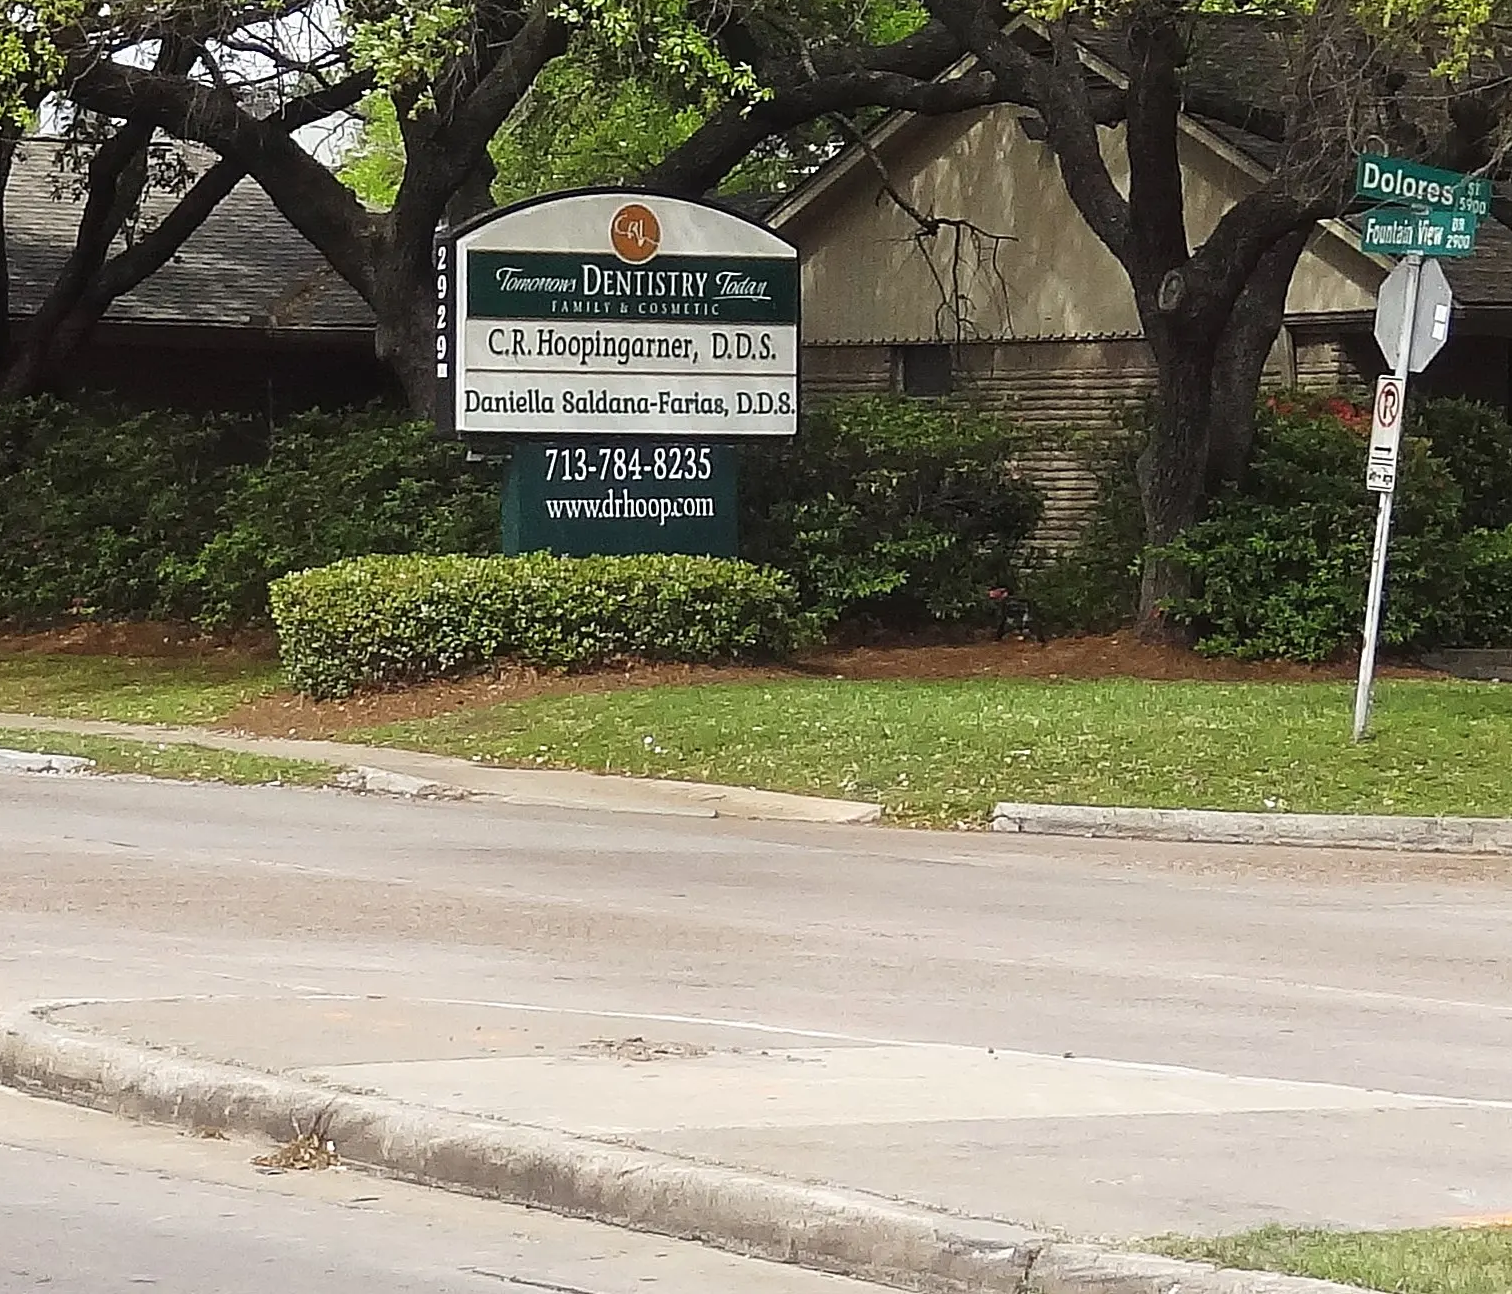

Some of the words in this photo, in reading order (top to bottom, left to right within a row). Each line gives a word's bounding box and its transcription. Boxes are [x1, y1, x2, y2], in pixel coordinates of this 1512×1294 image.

[1363, 162, 1454, 206] Dolores
[1467, 182, 1481, 196] ST
[1458, 197, 1487, 215] 5900
[1365, 218, 1414, 245] Fountain
[1417, 219, 1444, 246] View
[1445, 234, 1471, 249] 2900
[581, 264, 708, 297] DENTISTRY
[715, 271, 769, 301] Today
[436, 246, 447, 360] 2929
[551, 300, 611, 314] FAMILY
[619, 302, 629, 314] &
[638, 302, 720, 316] COSMETIC
[487, 328, 532, 356] C.R.
[536, 328, 699, 365] Hoopingarner,
[711, 332, 777, 360] D.D.S.
[464, 389, 555, 414] Daniella
[562, 389, 729, 417] Saldana-Farias,
[736, 391, 796, 415] D.D.S.
[545, 447, 711, 481] 713-784-8235
[545, 488, 715, 526] www.drhoop.com
